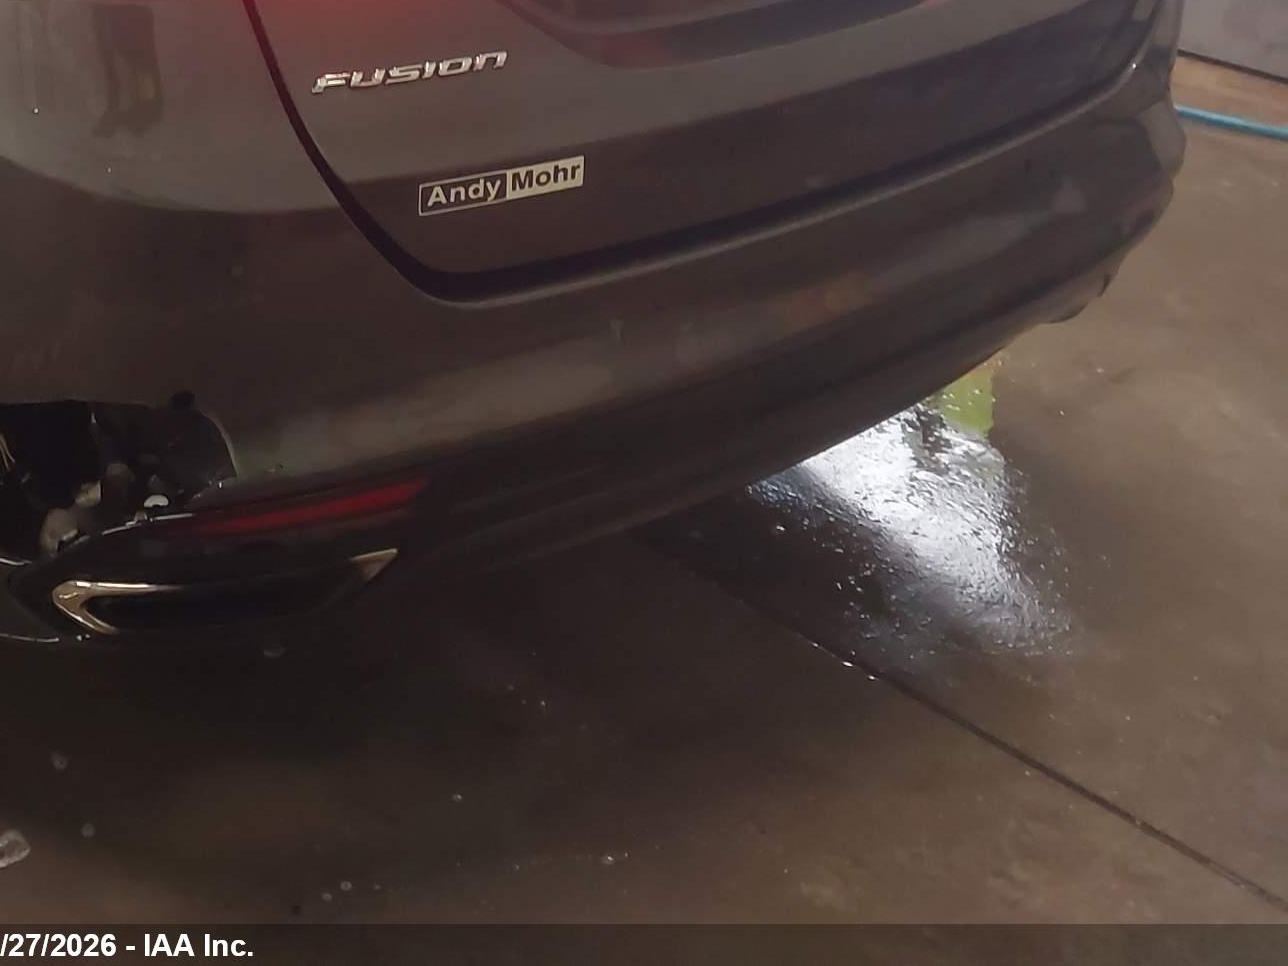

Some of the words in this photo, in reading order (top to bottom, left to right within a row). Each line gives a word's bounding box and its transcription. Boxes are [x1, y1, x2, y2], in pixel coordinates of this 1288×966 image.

[310, 50, 509, 95] FUSION
[426, 177, 504, 208] Andy
[510, 161, 582, 192] Mohr
